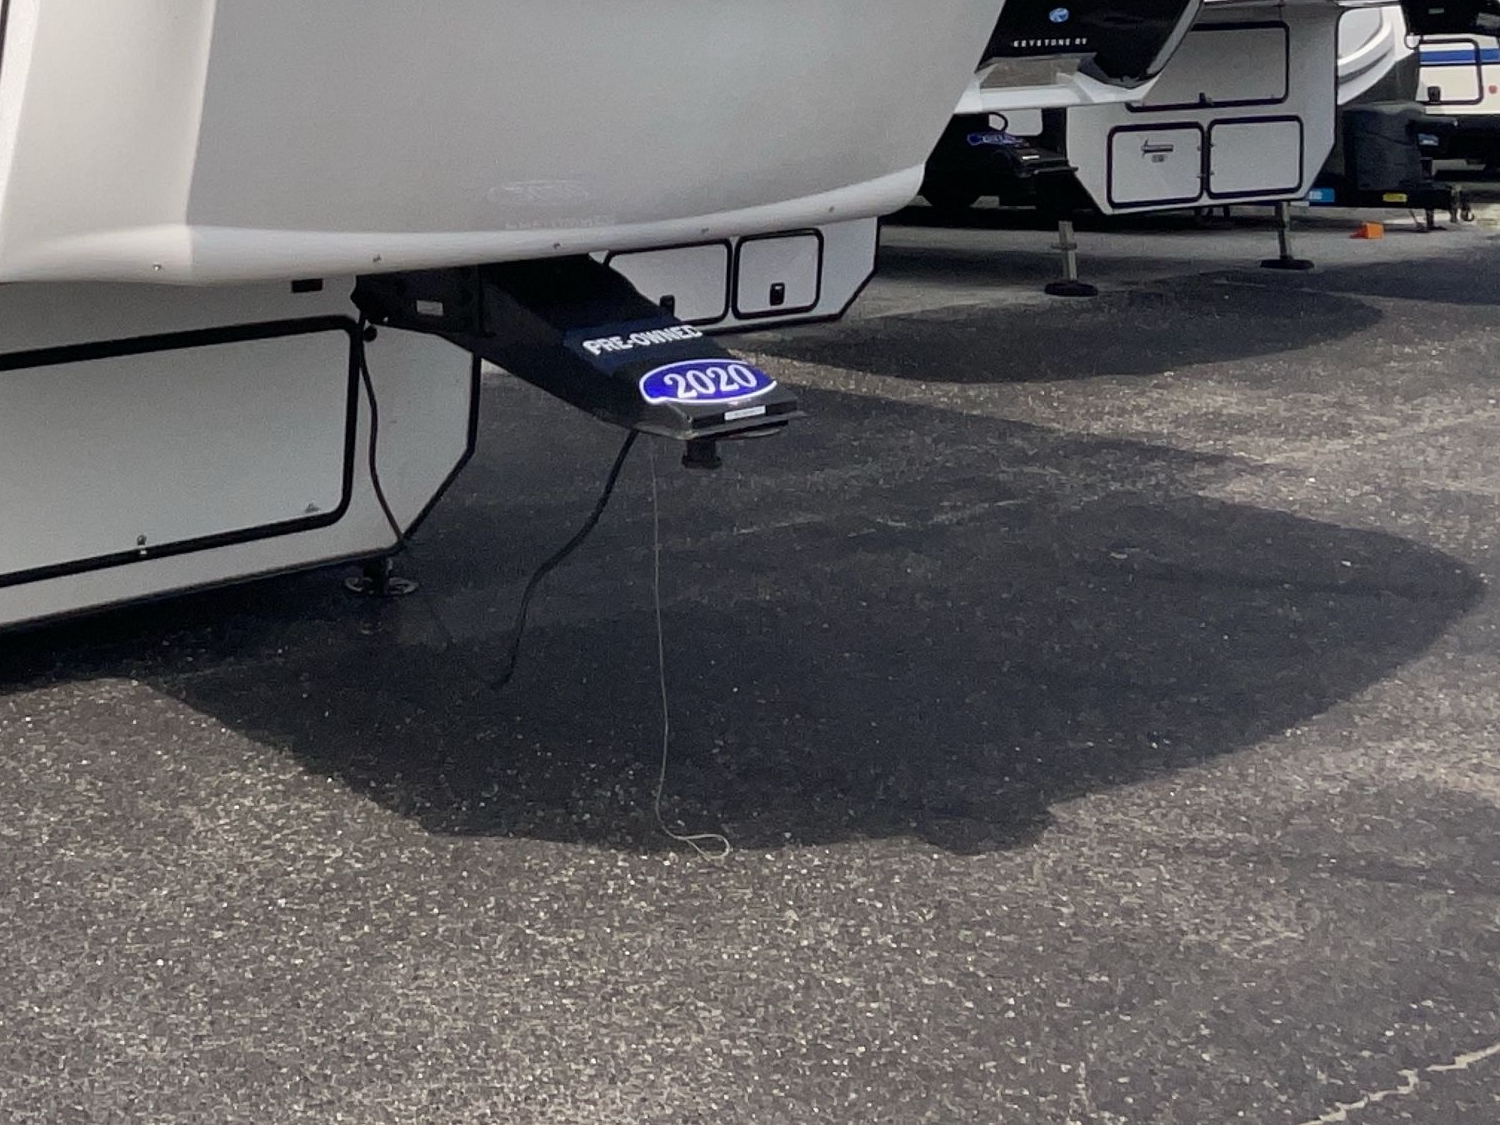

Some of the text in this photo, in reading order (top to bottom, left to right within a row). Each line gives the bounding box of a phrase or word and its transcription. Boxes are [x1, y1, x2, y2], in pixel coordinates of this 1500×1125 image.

[1013, 38, 1071, 48] KEYSTONE
[583, 324, 703, 356] PRE-OWNED
[663, 363, 758, 400] 2020
